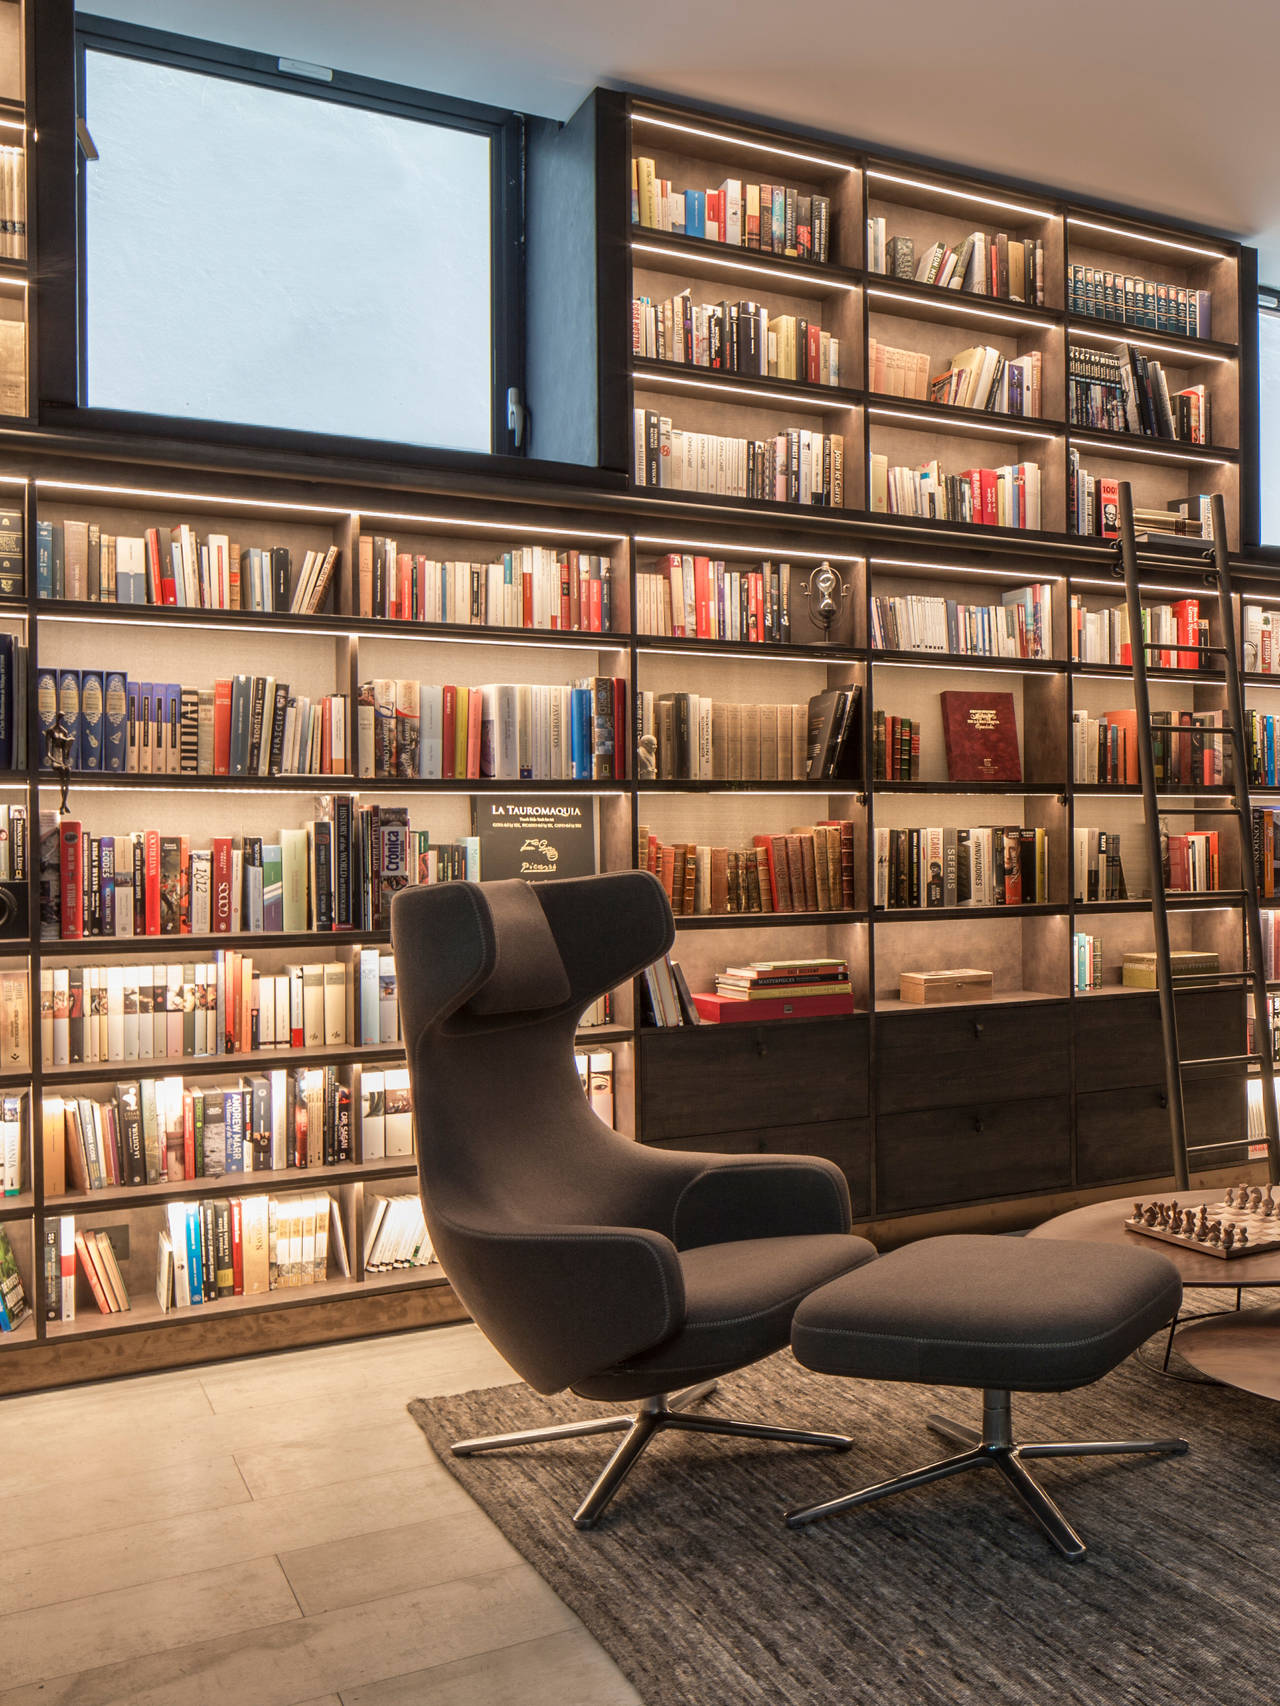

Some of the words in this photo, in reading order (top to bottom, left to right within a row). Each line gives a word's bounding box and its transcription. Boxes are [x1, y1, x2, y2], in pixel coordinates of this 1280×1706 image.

[834, 450, 843, 469] John
[1263, 638, 1271, 662] visual
[252, 713, 261, 742] TUDORS
[274, 710, 284, 753] PERICLES
[339, 807, 347, 835] HISTORY
[492, 805, 505, 815] LA
[506, 805, 582, 817] TAUROMAQUIA
[385, 831, 399, 872] Crónica
[1253, 820, 1261, 862] LONDON
[339, 852, 347, 877] WORLD
[194, 868, 209, 893] 1812
[219, 882, 229, 917] GODOS
[232, 1094, 242, 1132] ANDREW
[340, 1111, 349, 1124] CARL
[232, 1134, 241, 1159] MARR
[340, 1127, 349, 1148] SAGAN
[133, 1151, 140, 1159] LA
